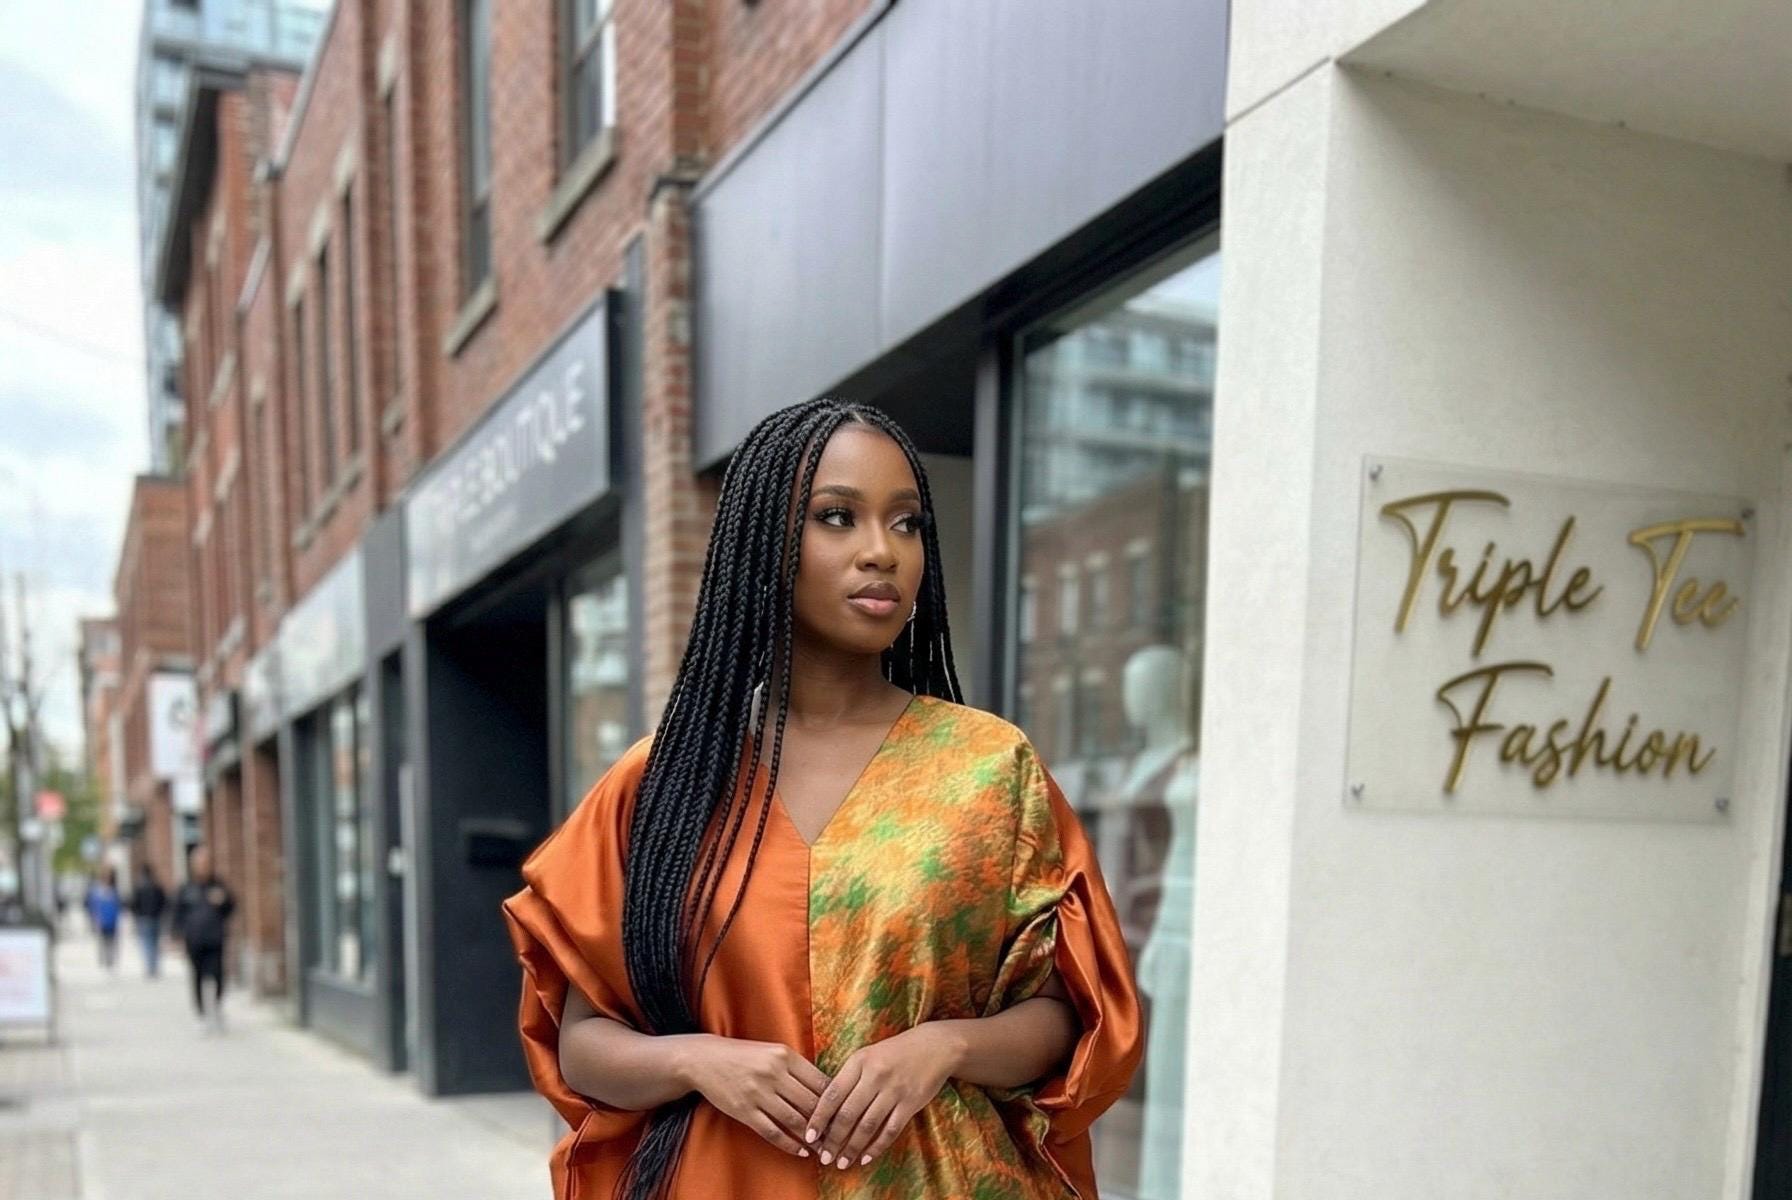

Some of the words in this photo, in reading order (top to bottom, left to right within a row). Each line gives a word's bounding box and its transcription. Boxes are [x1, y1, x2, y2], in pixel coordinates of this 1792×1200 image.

[1380, 490, 1604, 659] Triple
[1627, 516, 1746, 652] Tee
[1436, 661, 1716, 795] Fashion
